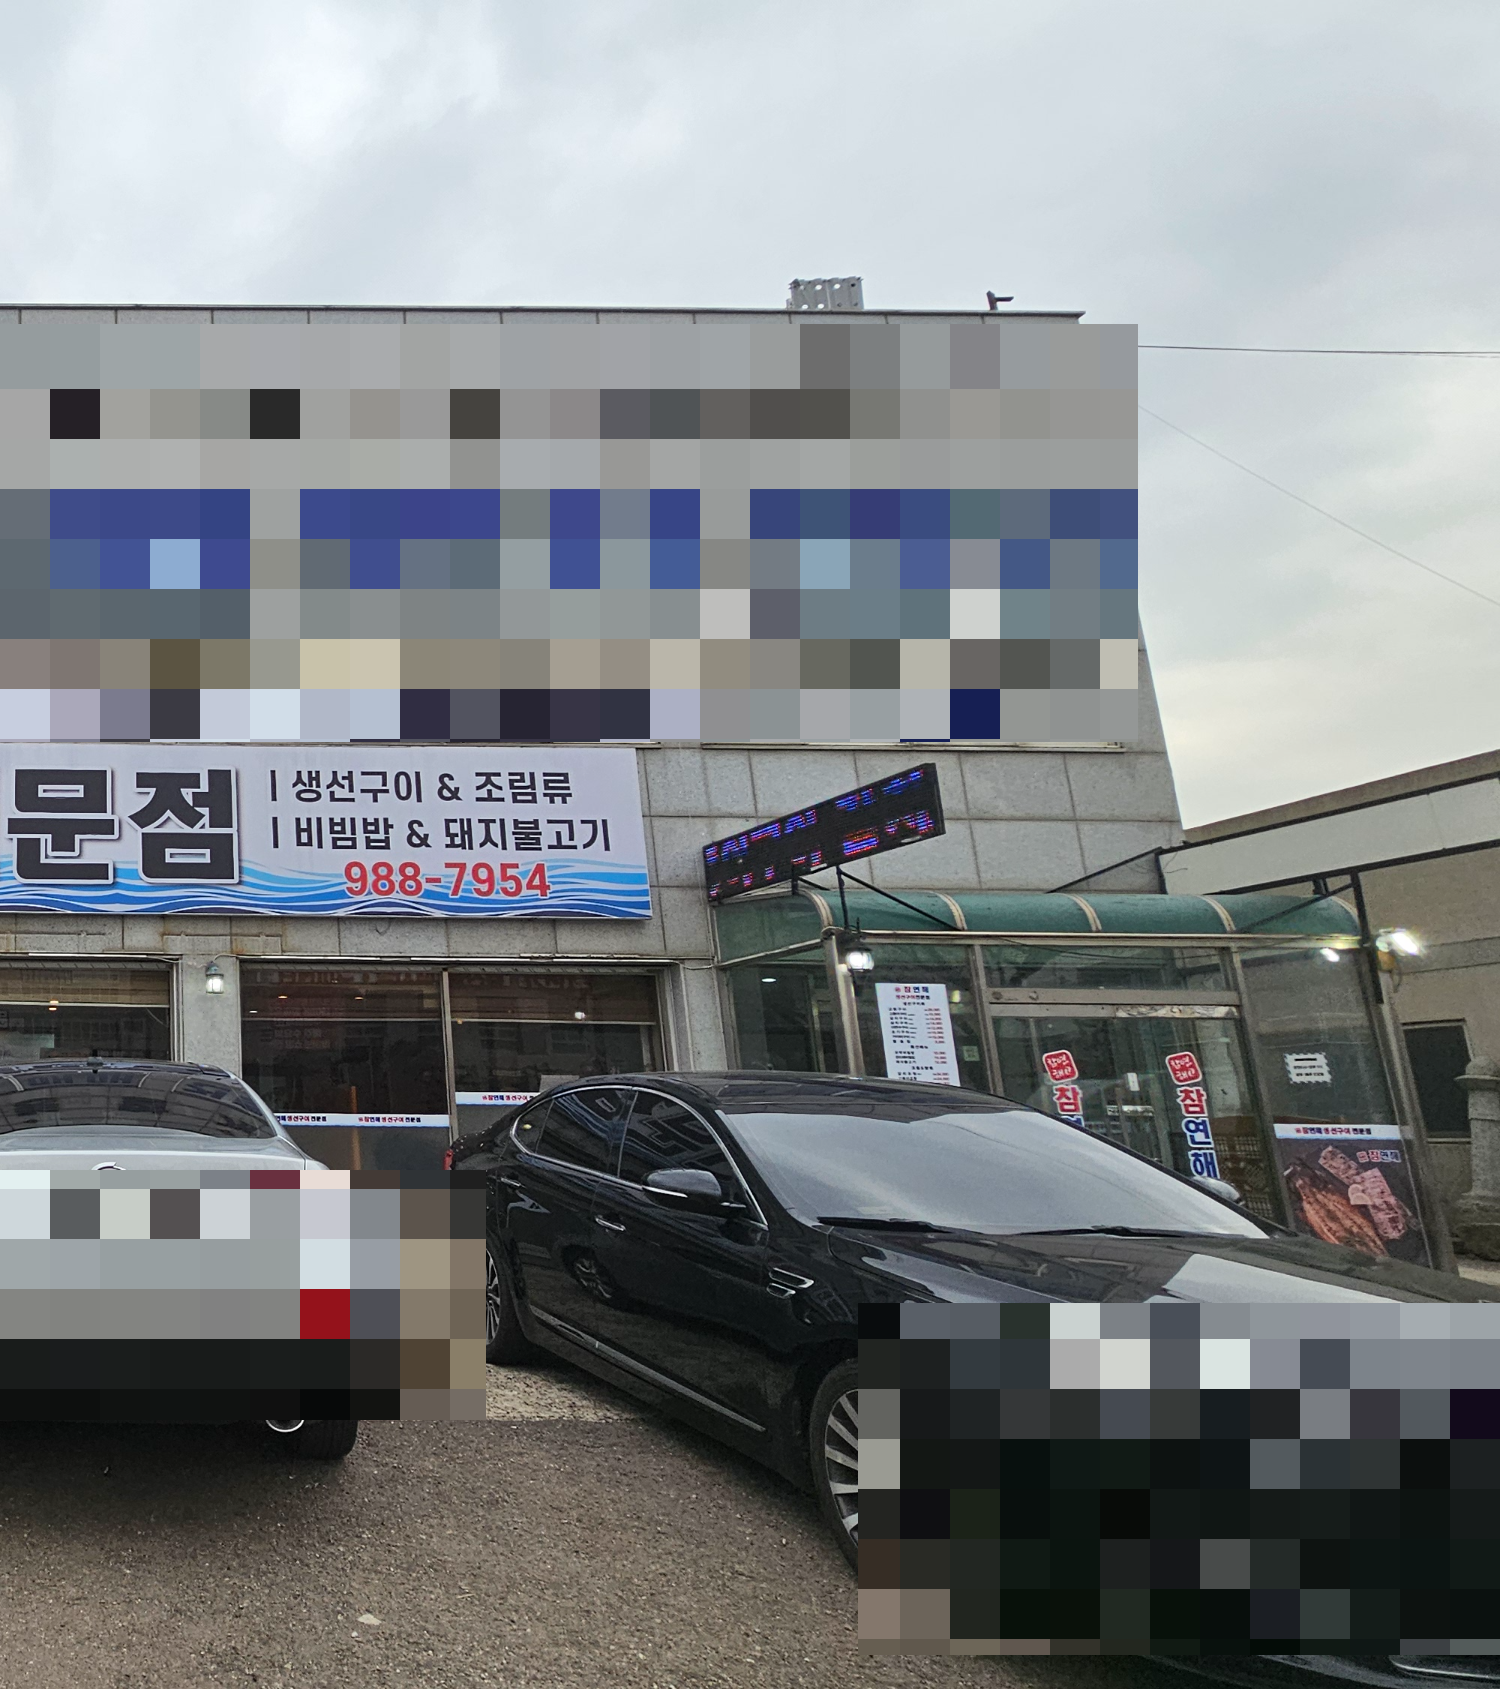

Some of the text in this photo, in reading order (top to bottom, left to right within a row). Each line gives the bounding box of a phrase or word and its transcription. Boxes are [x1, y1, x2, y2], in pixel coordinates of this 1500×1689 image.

[291, 769, 573, 804] 생선구이 & 조림류
[295, 816, 611, 852] 비빔밥 & 돼지불고기
[344, 861, 551, 898] 988-7954
[1178, 1087, 1220, 1179] 참연해
